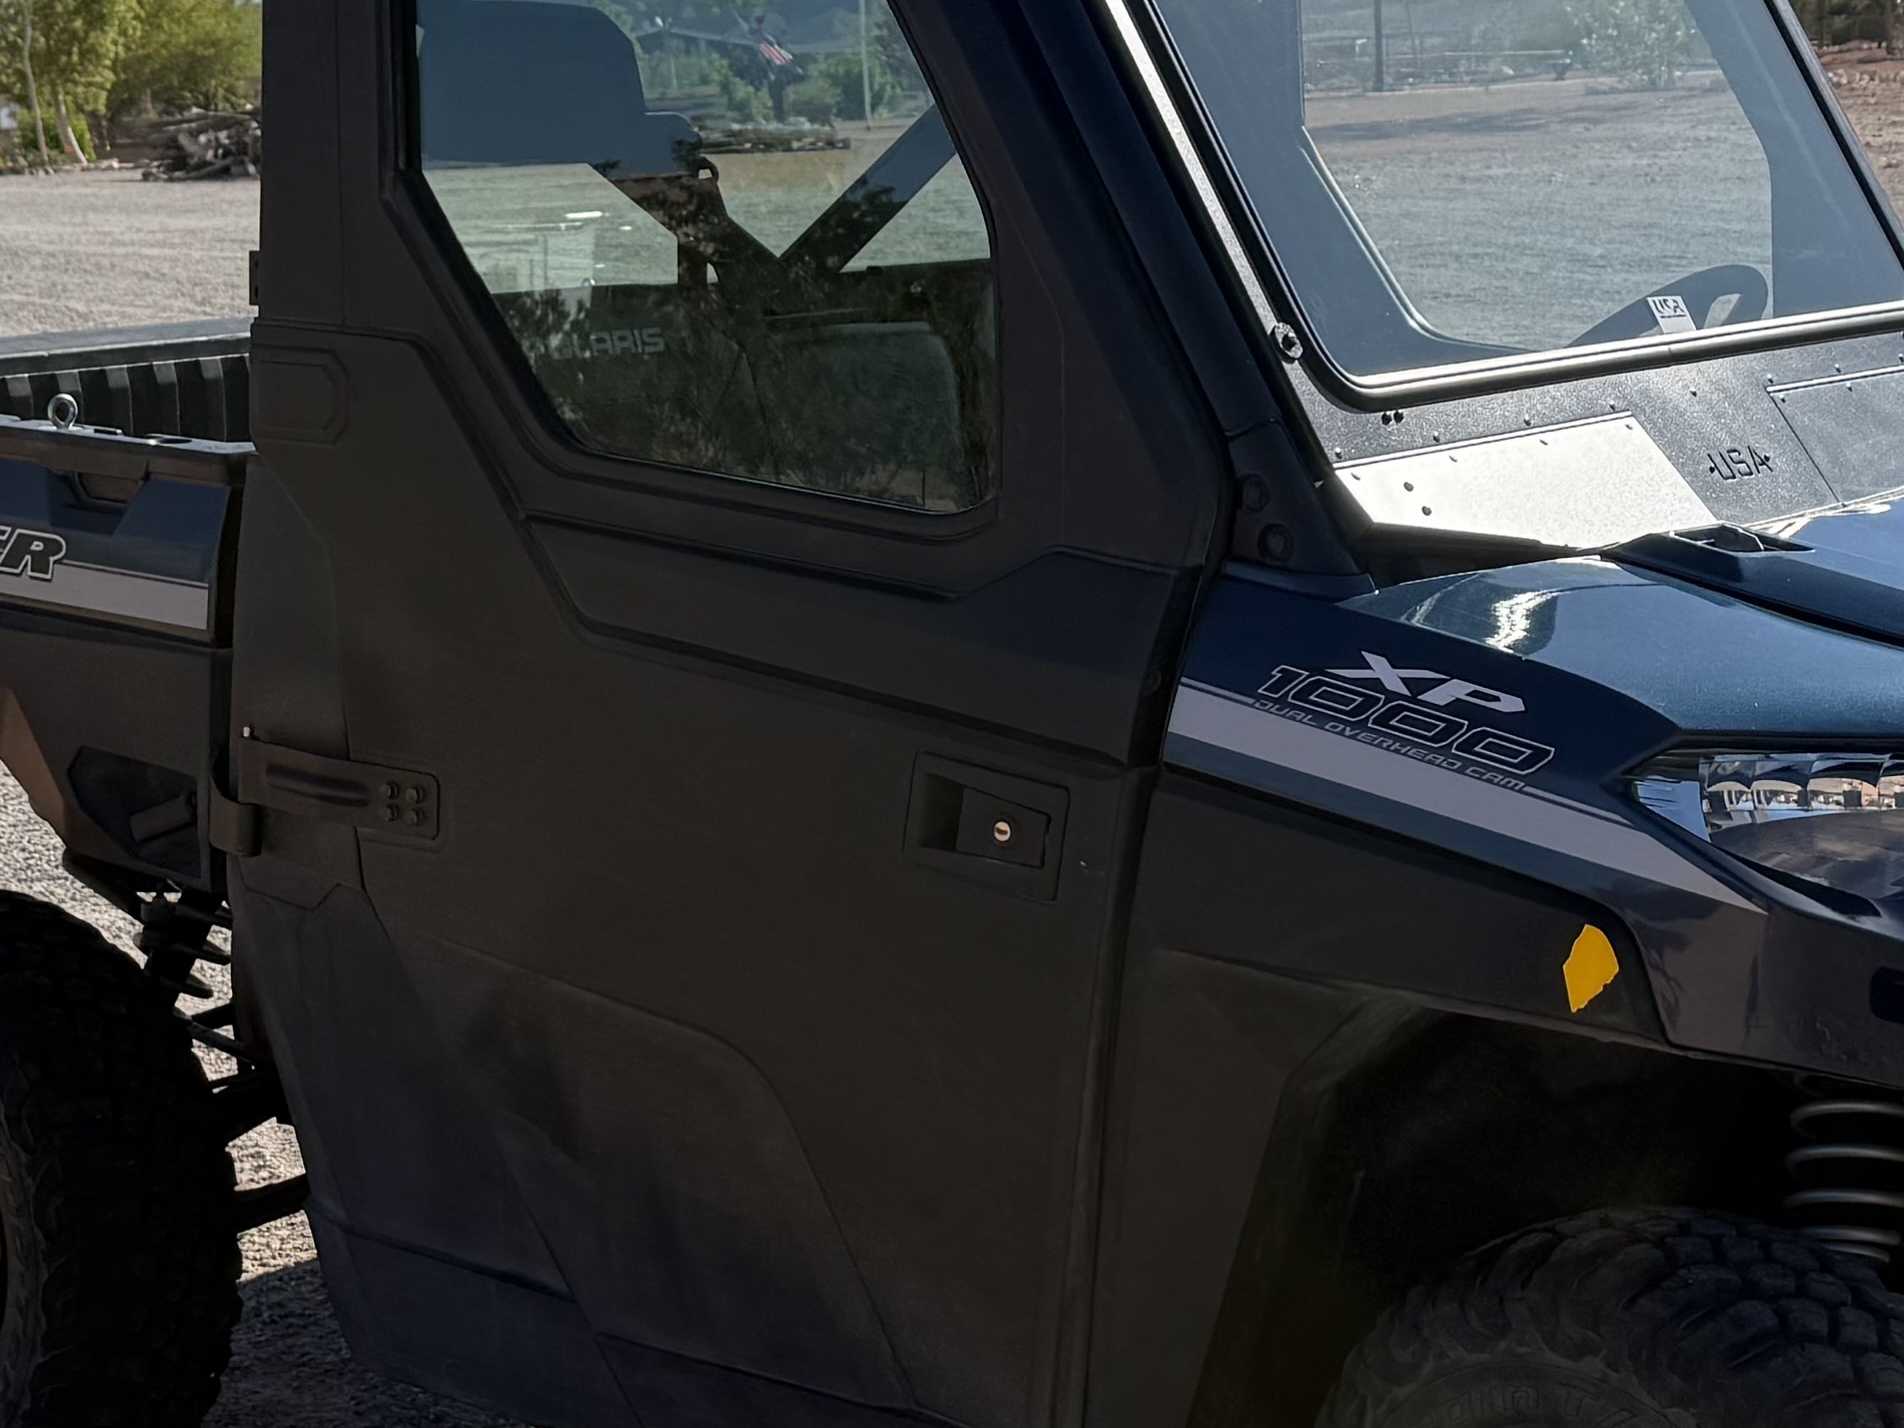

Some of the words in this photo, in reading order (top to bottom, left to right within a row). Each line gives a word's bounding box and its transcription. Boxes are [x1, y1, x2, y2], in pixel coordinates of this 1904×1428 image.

[1707, 445, 1773, 480] USA
[1257, 664, 1556, 776] 1000
[1325, 650, 1526, 713] XP
[1251, 698, 1319, 727] DUAL
[1324, 721, 1463, 771] OVERHEAD
[1465, 766, 1527, 792] CAM
